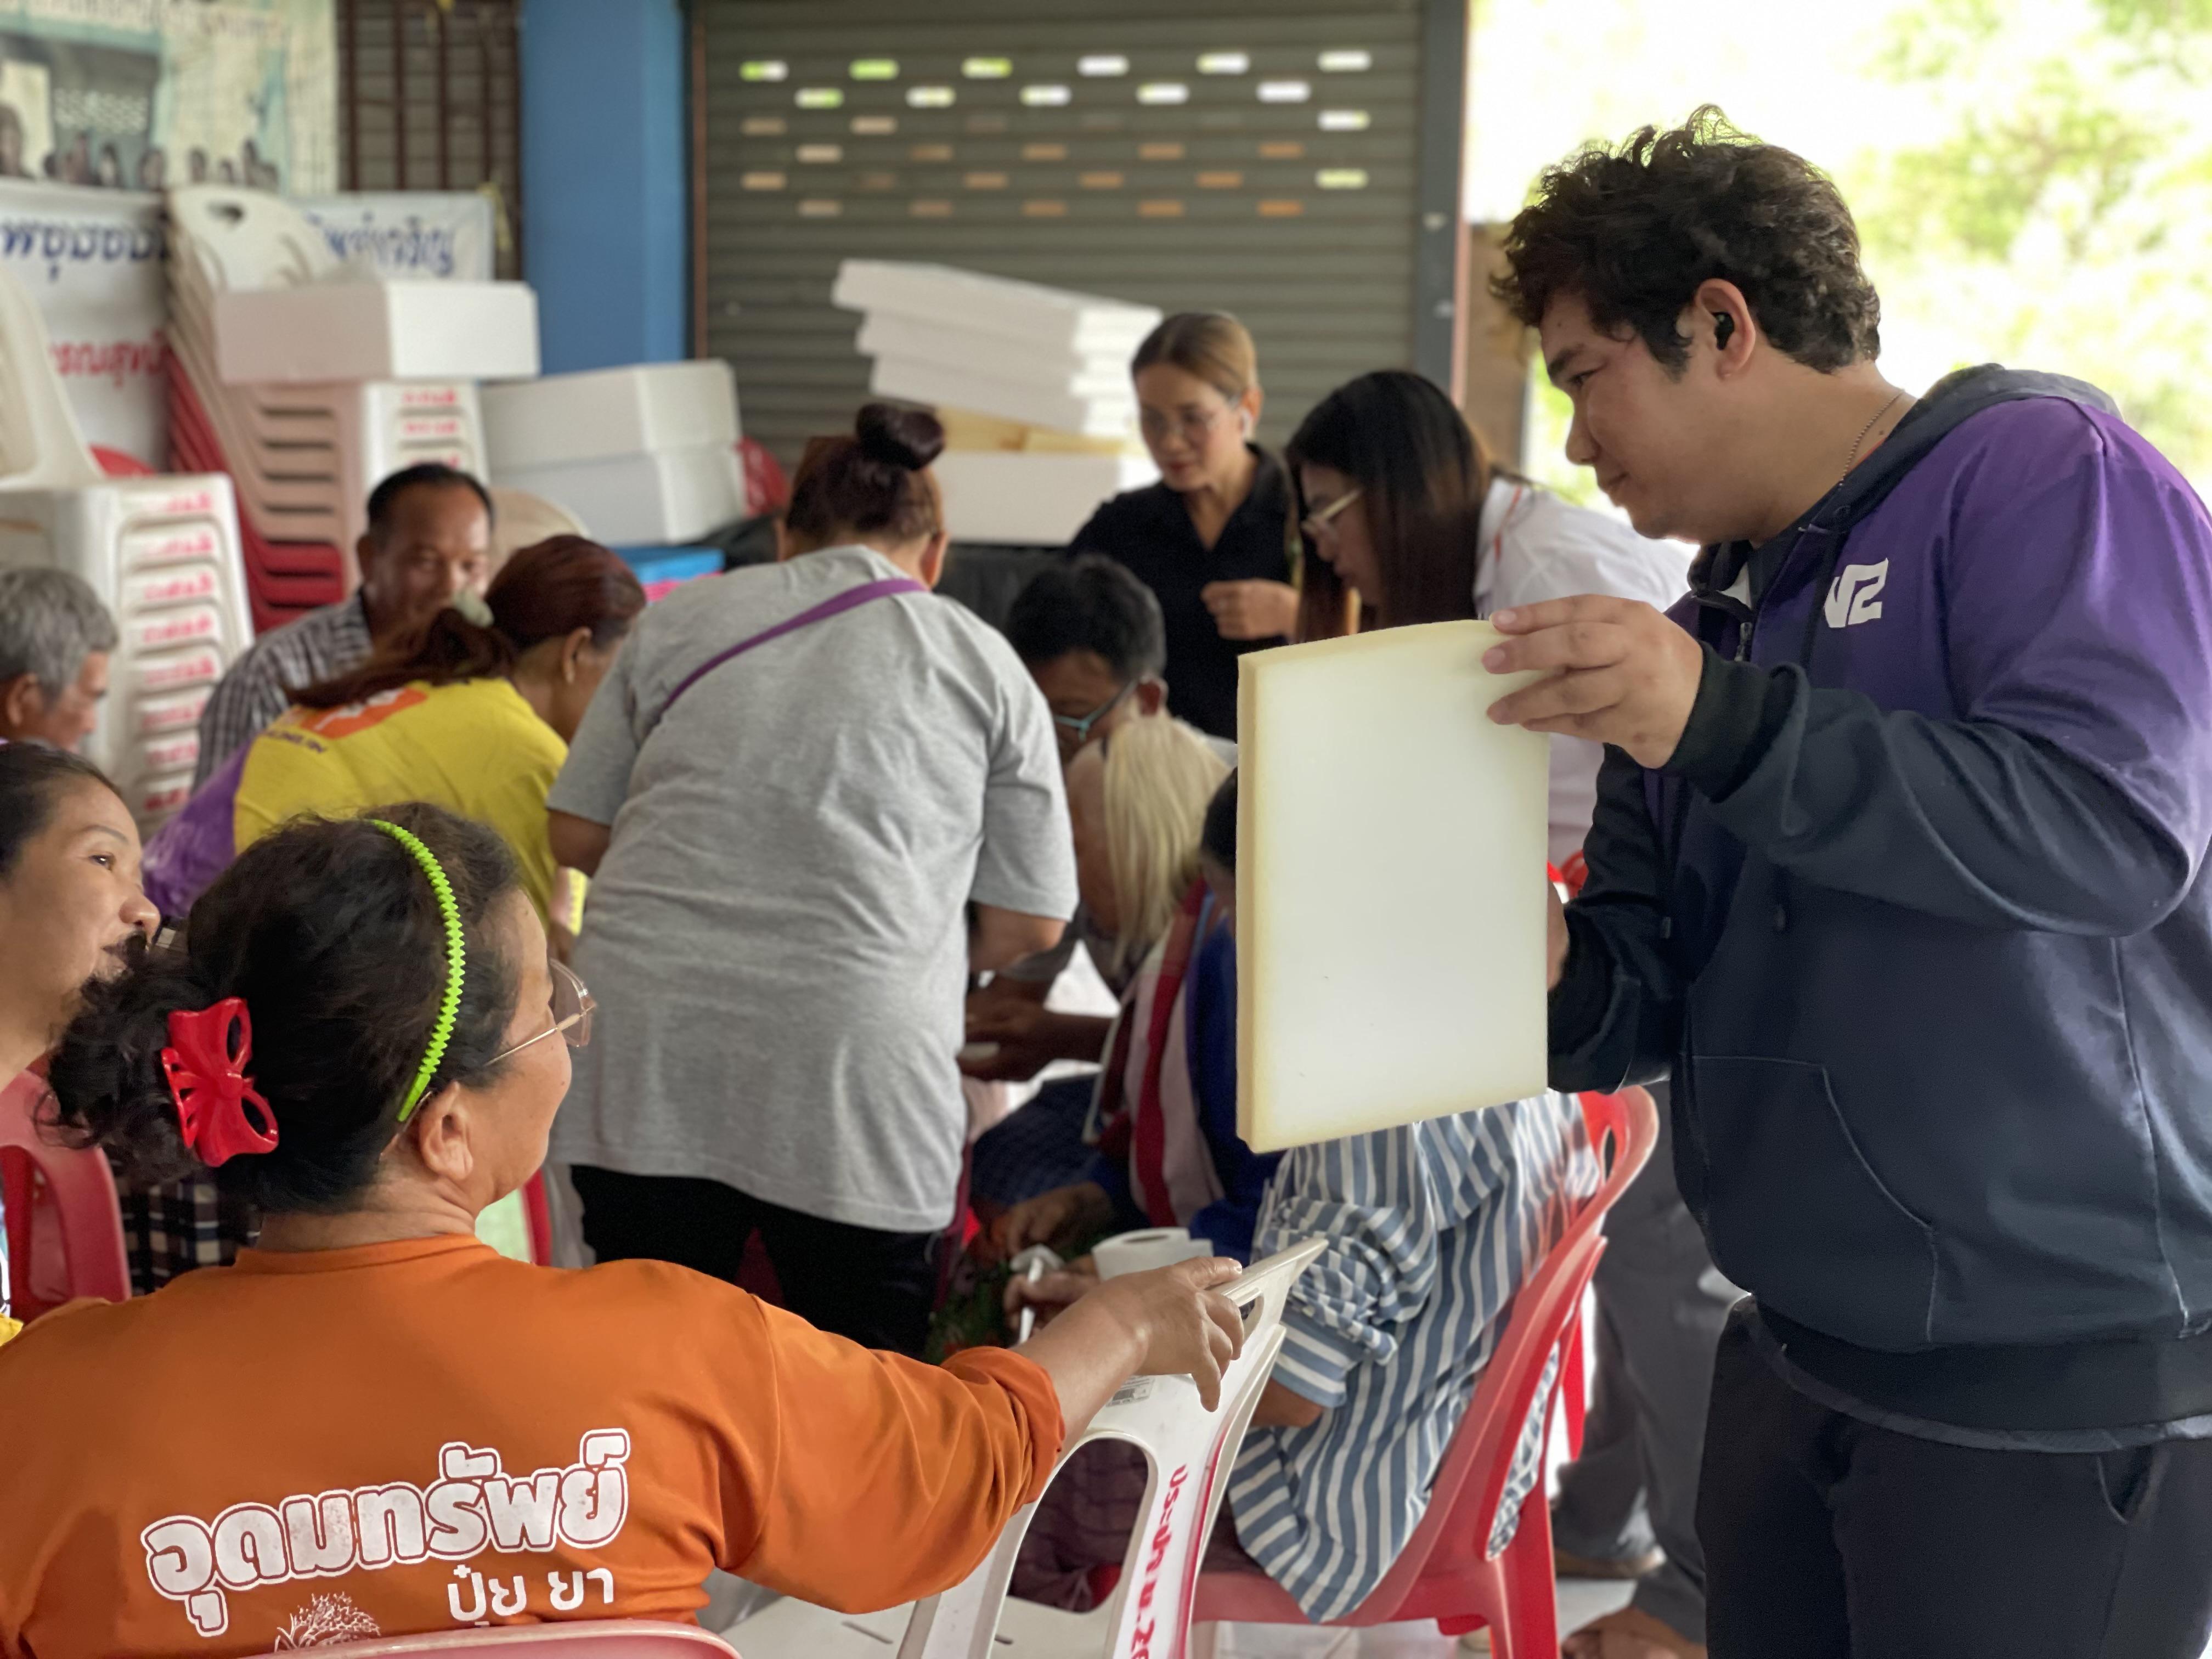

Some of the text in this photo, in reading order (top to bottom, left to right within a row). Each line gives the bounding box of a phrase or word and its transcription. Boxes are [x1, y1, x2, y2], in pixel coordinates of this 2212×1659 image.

[140, 1428, 630, 1637] อุดมทรัพย์
[549, 1567, 614, 1611] ยา
